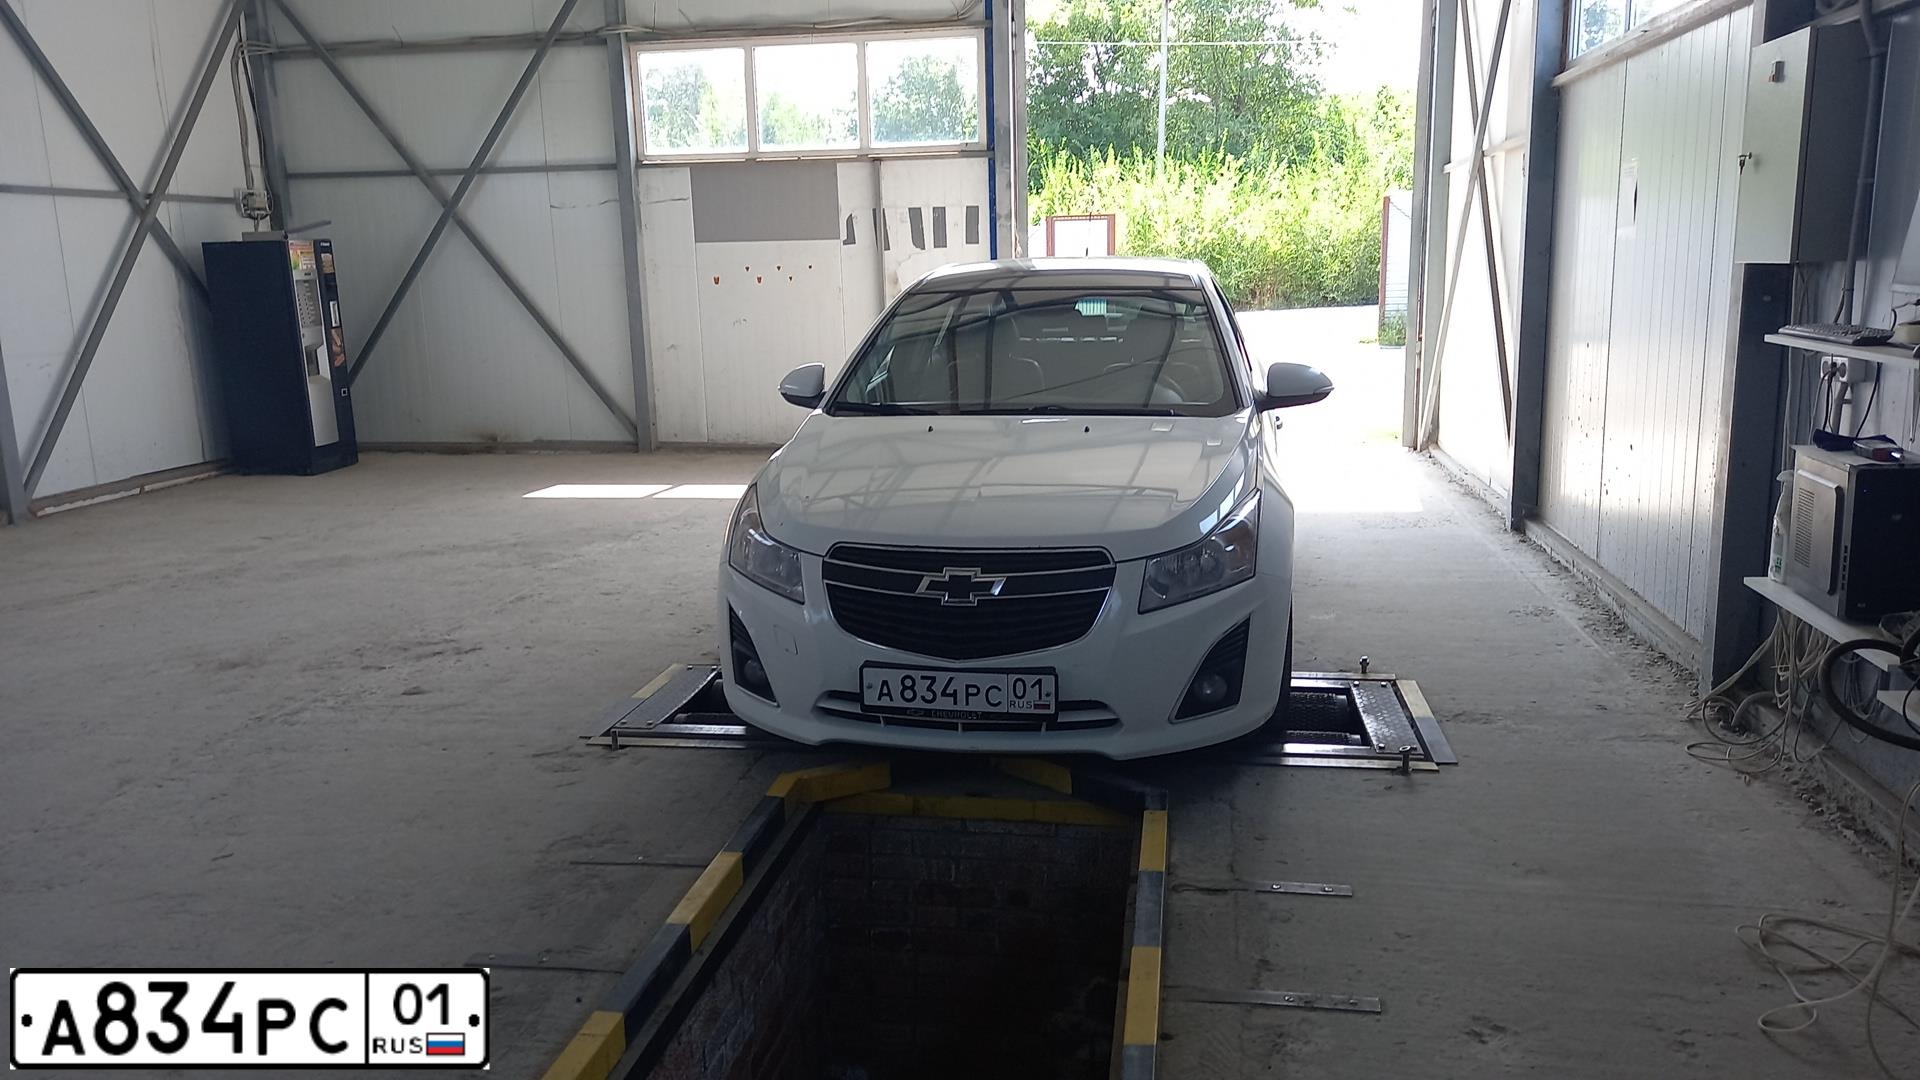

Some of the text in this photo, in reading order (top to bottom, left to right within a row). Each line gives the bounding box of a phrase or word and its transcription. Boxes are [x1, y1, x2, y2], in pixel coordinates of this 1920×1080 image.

[877, 674, 1044, 707] А834РС 01
[1009, 701, 1033, 709] RUS
